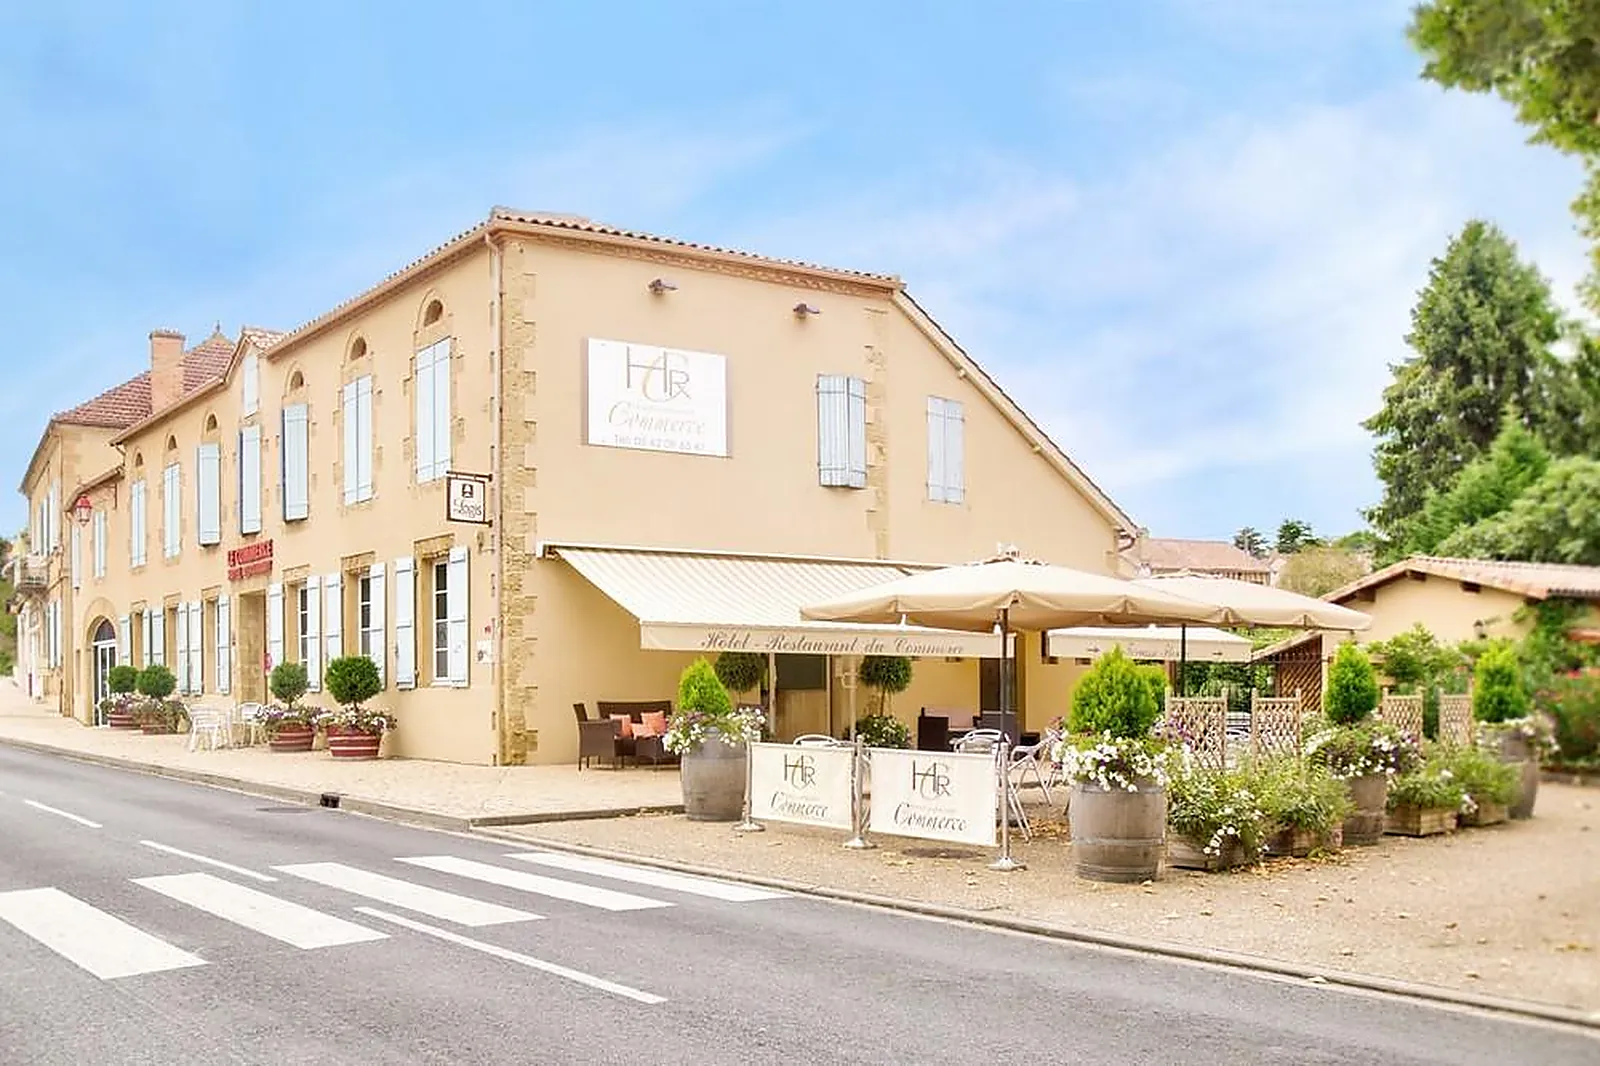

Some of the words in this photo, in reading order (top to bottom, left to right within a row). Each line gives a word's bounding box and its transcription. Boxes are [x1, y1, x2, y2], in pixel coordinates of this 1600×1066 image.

[607, 401, 705, 435] Commerce
[765, 633, 858, 652] Restaurant
[864, 638, 884, 653] du
[895, 638, 963, 655] Commerce
[770, 791, 829, 818] Commerce
[894, 801, 967, 832] Commerce
